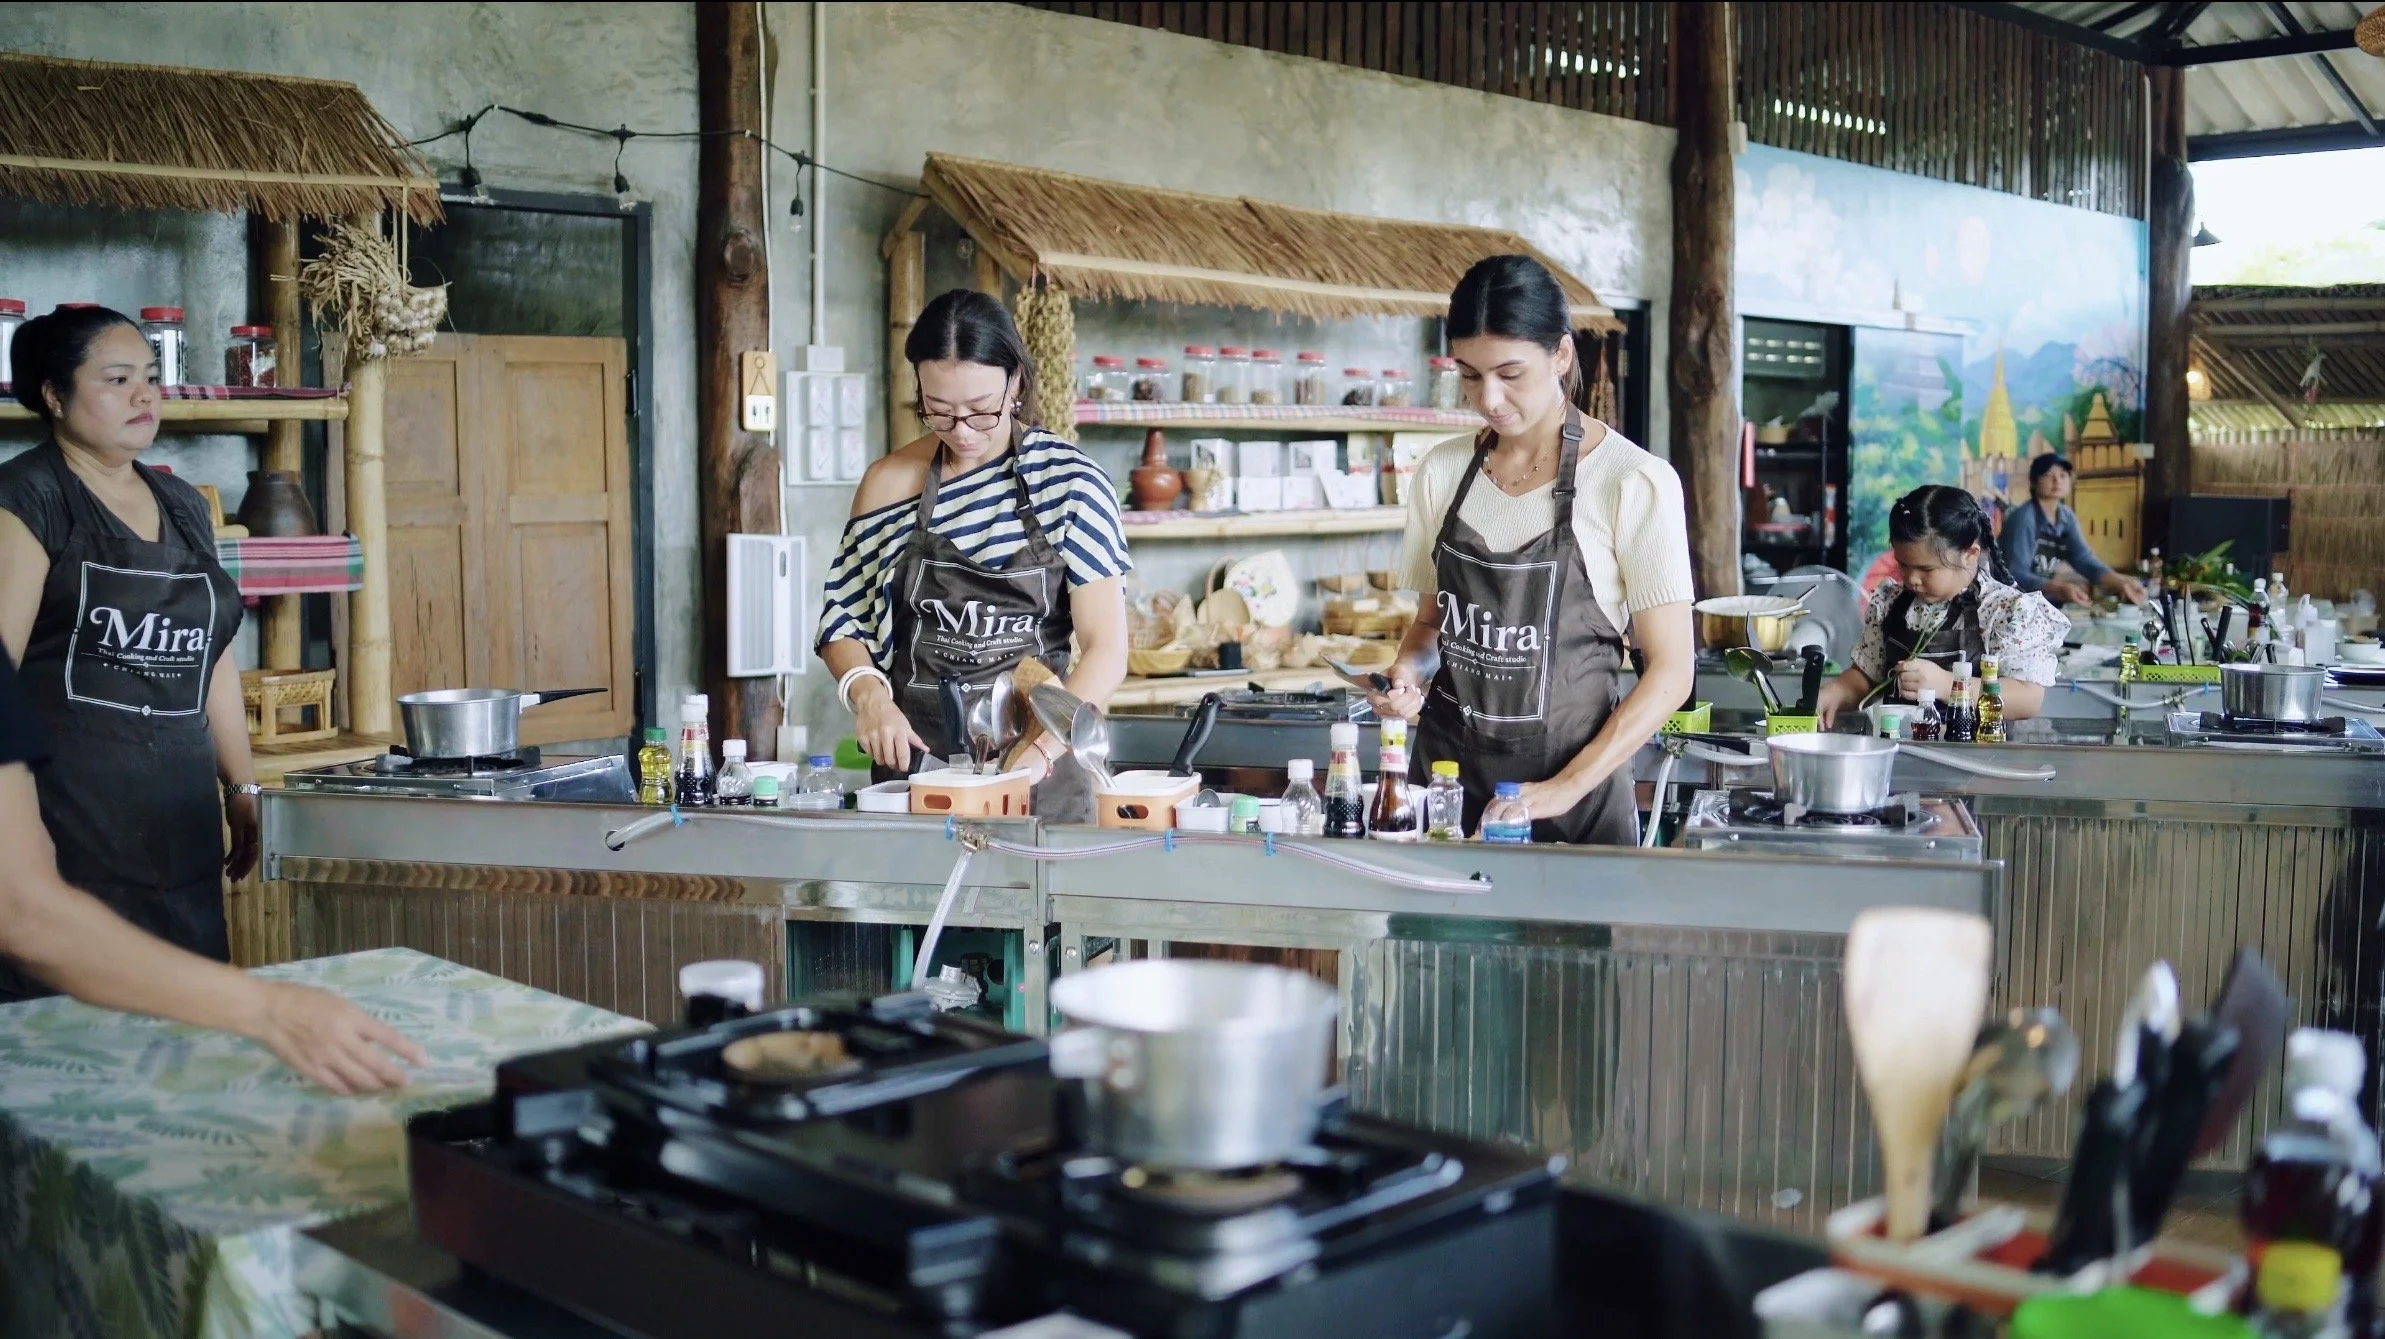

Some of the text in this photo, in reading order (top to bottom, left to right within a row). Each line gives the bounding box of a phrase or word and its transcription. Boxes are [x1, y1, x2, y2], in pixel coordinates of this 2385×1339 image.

[919, 599, 1034, 638] Mira
[1436, 590, 1541, 652] Mira
[89, 606, 204, 653] Mira
[937, 635, 951, 644] Thai
[951, 638, 973, 649] Cooking
[974, 641, 986, 649] and
[1003, 636, 1023, 644] studio
[1450, 641, 1476, 657] Cooking
[1486, 653, 1504, 662] Craft
[1505, 655, 1527, 663] studio
[98, 647, 114, 657] Thai
[116, 652, 144, 662] Cooking
[943, 652, 1007, 664] CHIANG MAI
[1446, 660, 1505, 681] CHIANG MAI
